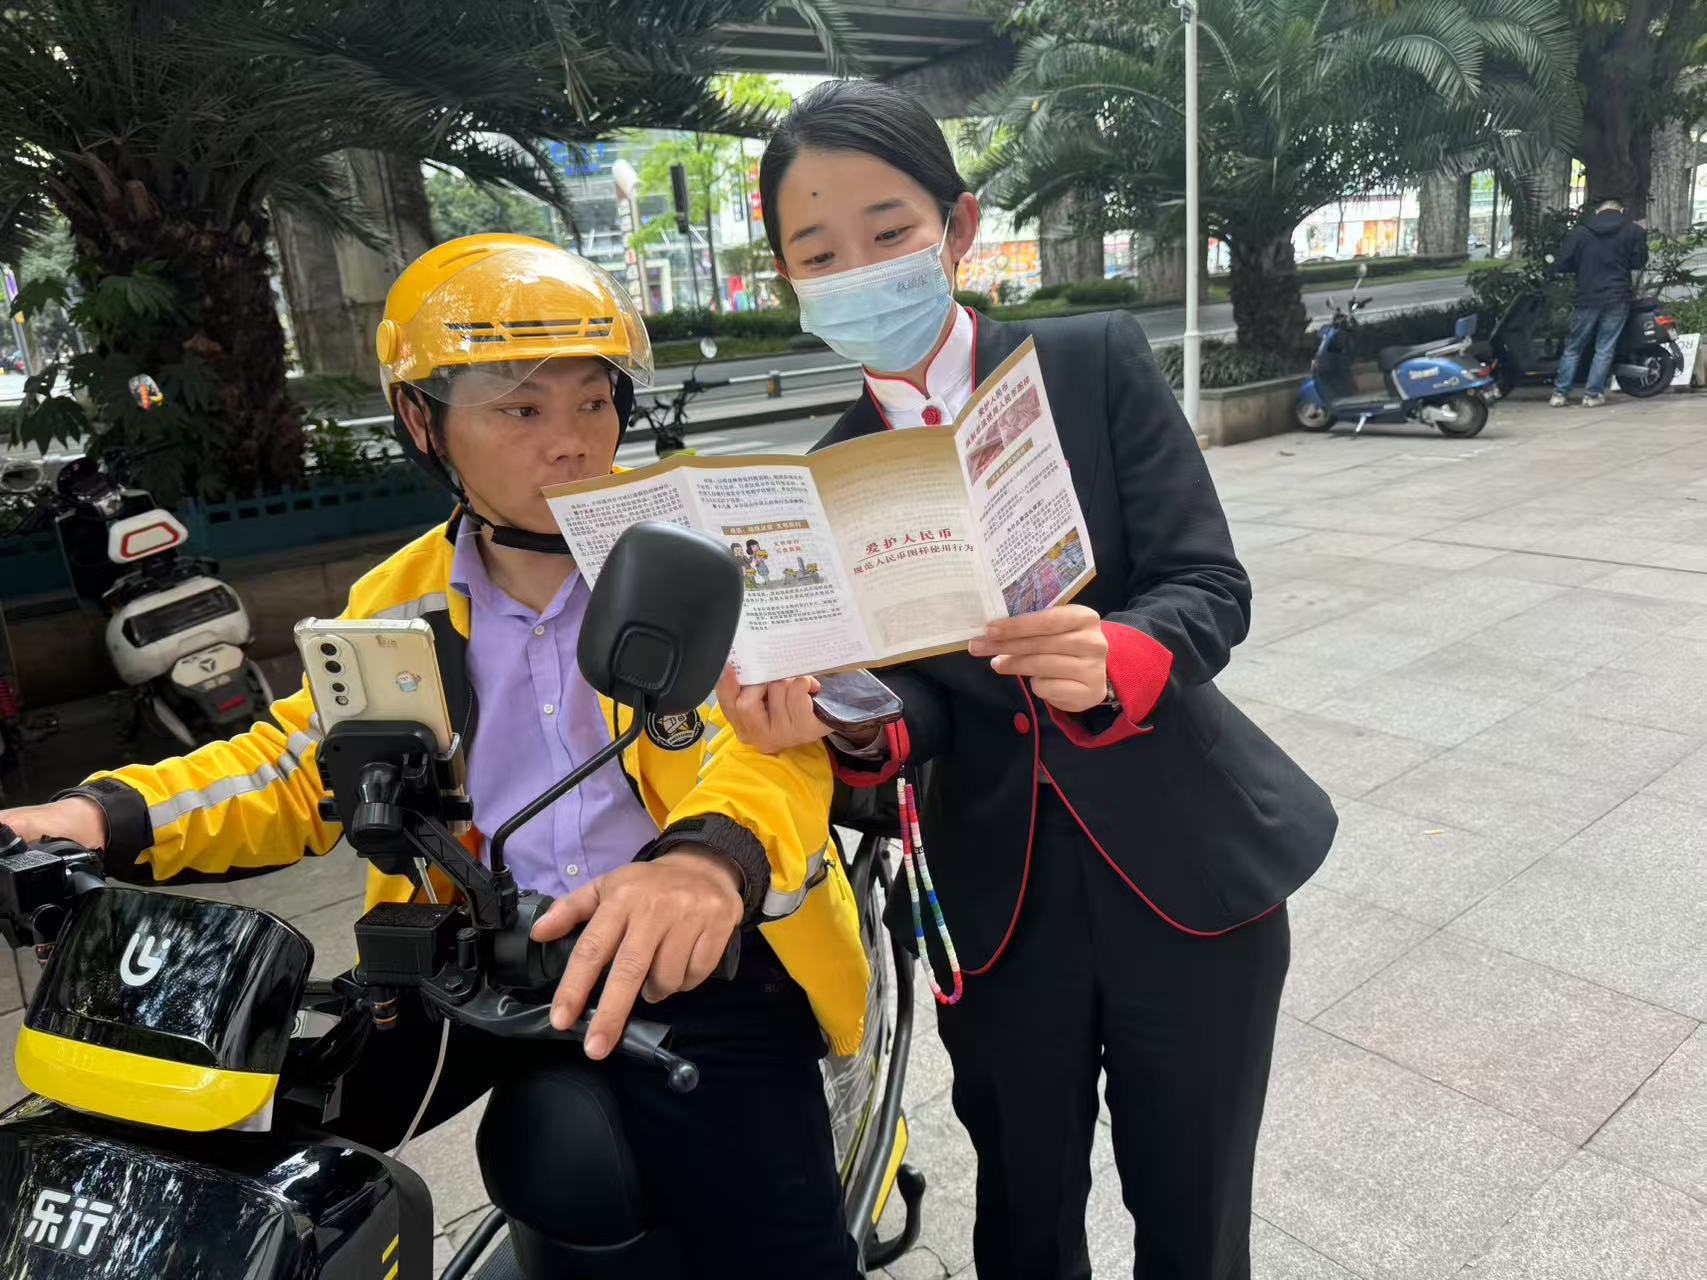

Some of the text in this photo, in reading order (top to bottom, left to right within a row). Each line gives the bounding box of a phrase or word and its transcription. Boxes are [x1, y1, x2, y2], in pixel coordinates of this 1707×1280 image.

[978, 381, 1009, 418] 爱护人民币
[865, 528, 952, 555] 爱护人民币
[853, 543, 975, 575] 规范人民币图样使用行为
[23, 1189, 113, 1256] 乐行
